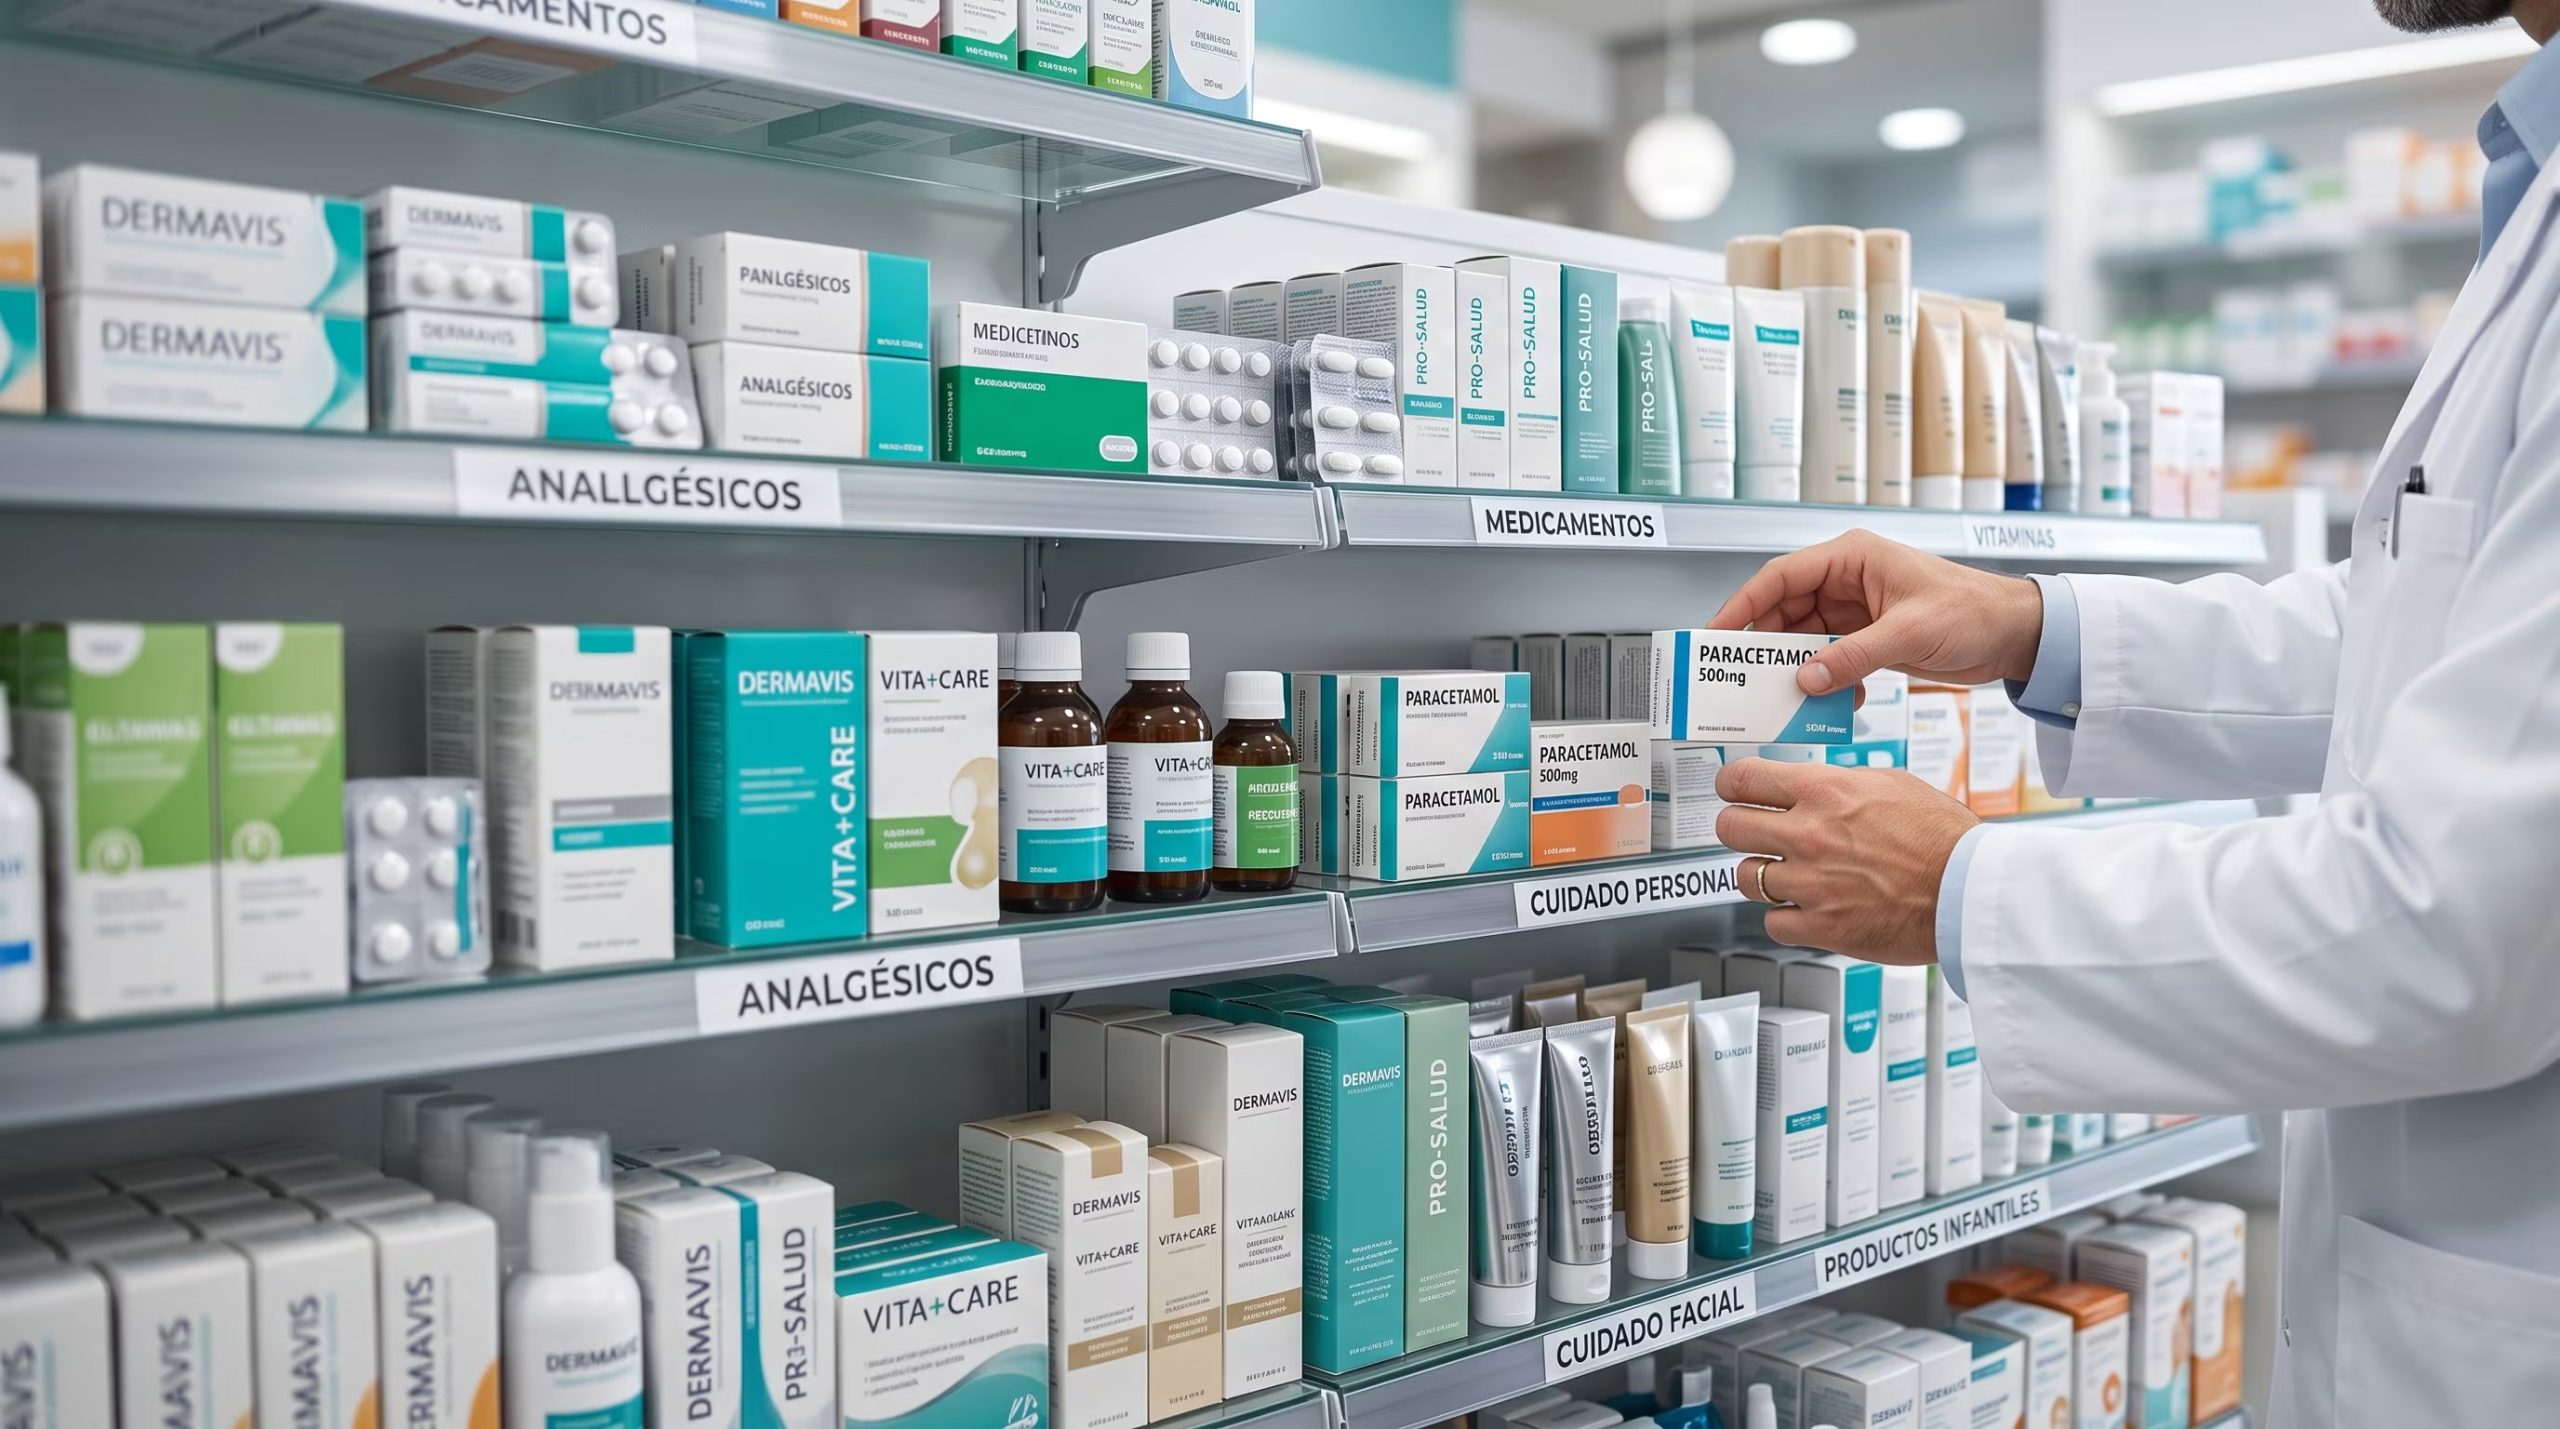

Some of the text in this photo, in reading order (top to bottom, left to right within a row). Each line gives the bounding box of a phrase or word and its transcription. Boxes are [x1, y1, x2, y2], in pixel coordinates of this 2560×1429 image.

[442, 0, 668, 45] MENTOS
[102, 196, 286, 247] DERMAVIS
[101, 320, 284, 364] DERMAVIS
[973, 322, 1080, 349] MEDICETINOS
[1470, 297, 1483, 399] PRO-SALUD
[1523, 286, 1536, 399] PRO-SALUD
[1578, 292, 1592, 412] PRO-SALUD
[740, 375, 852, 400] ANALGÉSICOS
[508, 467, 801, 510] ANALLGÉSICOS
[1485, 508, 1655, 538] MEDICAMENTOS
[1972, 526, 2055, 549] VITAMINAS
[1699, 645, 1818, 666] PARACETAMO
[738, 670, 855, 695] DERMAVIS
[880, 669, 990, 691] VITA+CARE
[1405, 687, 1500, 707] PARACETAMOL
[1539, 741, 1638, 764] PARACETAMOL
[1024, 760, 1105, 780] VITA+CARE
[1540, 767, 1578, 784] 500mg
[1405, 787, 1500, 810] PARACETAMOL
[830, 725, 857, 912] VITA+CARE
[1530, 867, 1739, 916] CUIDADO PERSONAL
[738, 955, 994, 1017] ANALGÉSICOS
[1342, 1064, 1401, 1089] DERMAVIS
[1233, 1087, 1298, 1112] DERMAVIS
[1429, 1058, 1448, 1216] PRO-SALUD
[1072, 1190, 1141, 1216] DERMAVIS
[1158, 1223, 1217, 1247] VITA+CARE
[1824, 1190, 2041, 1282] PRODUCTOS INFANTILES
[1075, 1242, 1140, 1267] VITA+CARE
[863, 1275, 1020, 1335] VITA+CARE
[685, 1244, 712, 1421] DERMAVIS
[1556, 1286, 1745, 1368] CUIDADO FACIAL
[288, 1295, 321, 1429] MAVIS
